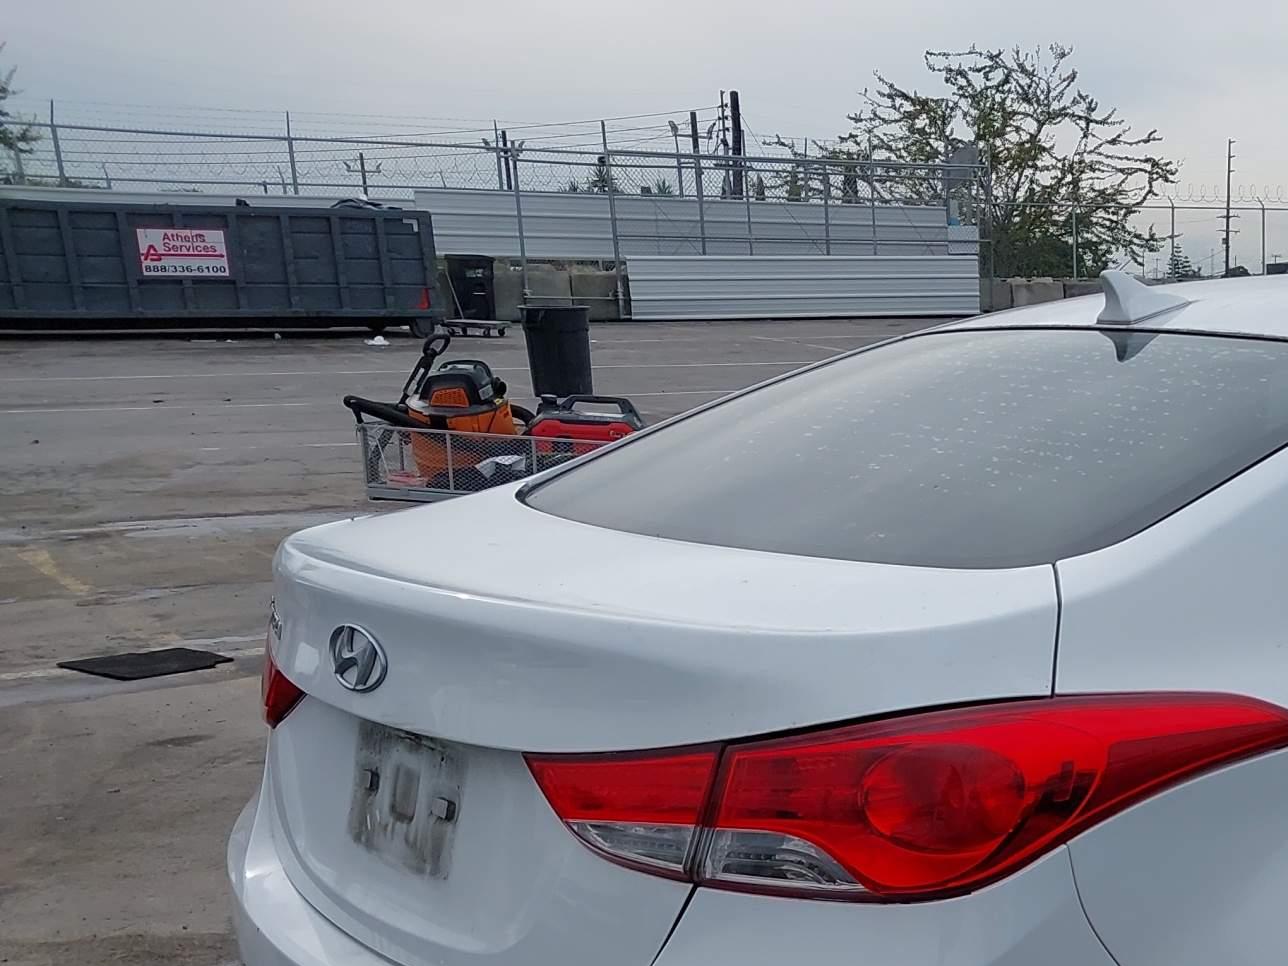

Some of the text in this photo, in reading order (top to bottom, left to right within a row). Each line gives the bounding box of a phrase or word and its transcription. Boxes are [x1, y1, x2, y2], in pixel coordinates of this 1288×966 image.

[162, 232, 206, 243] Athens
[163, 242, 217, 253] Services
[144, 264, 227, 274] 888/336-6100
